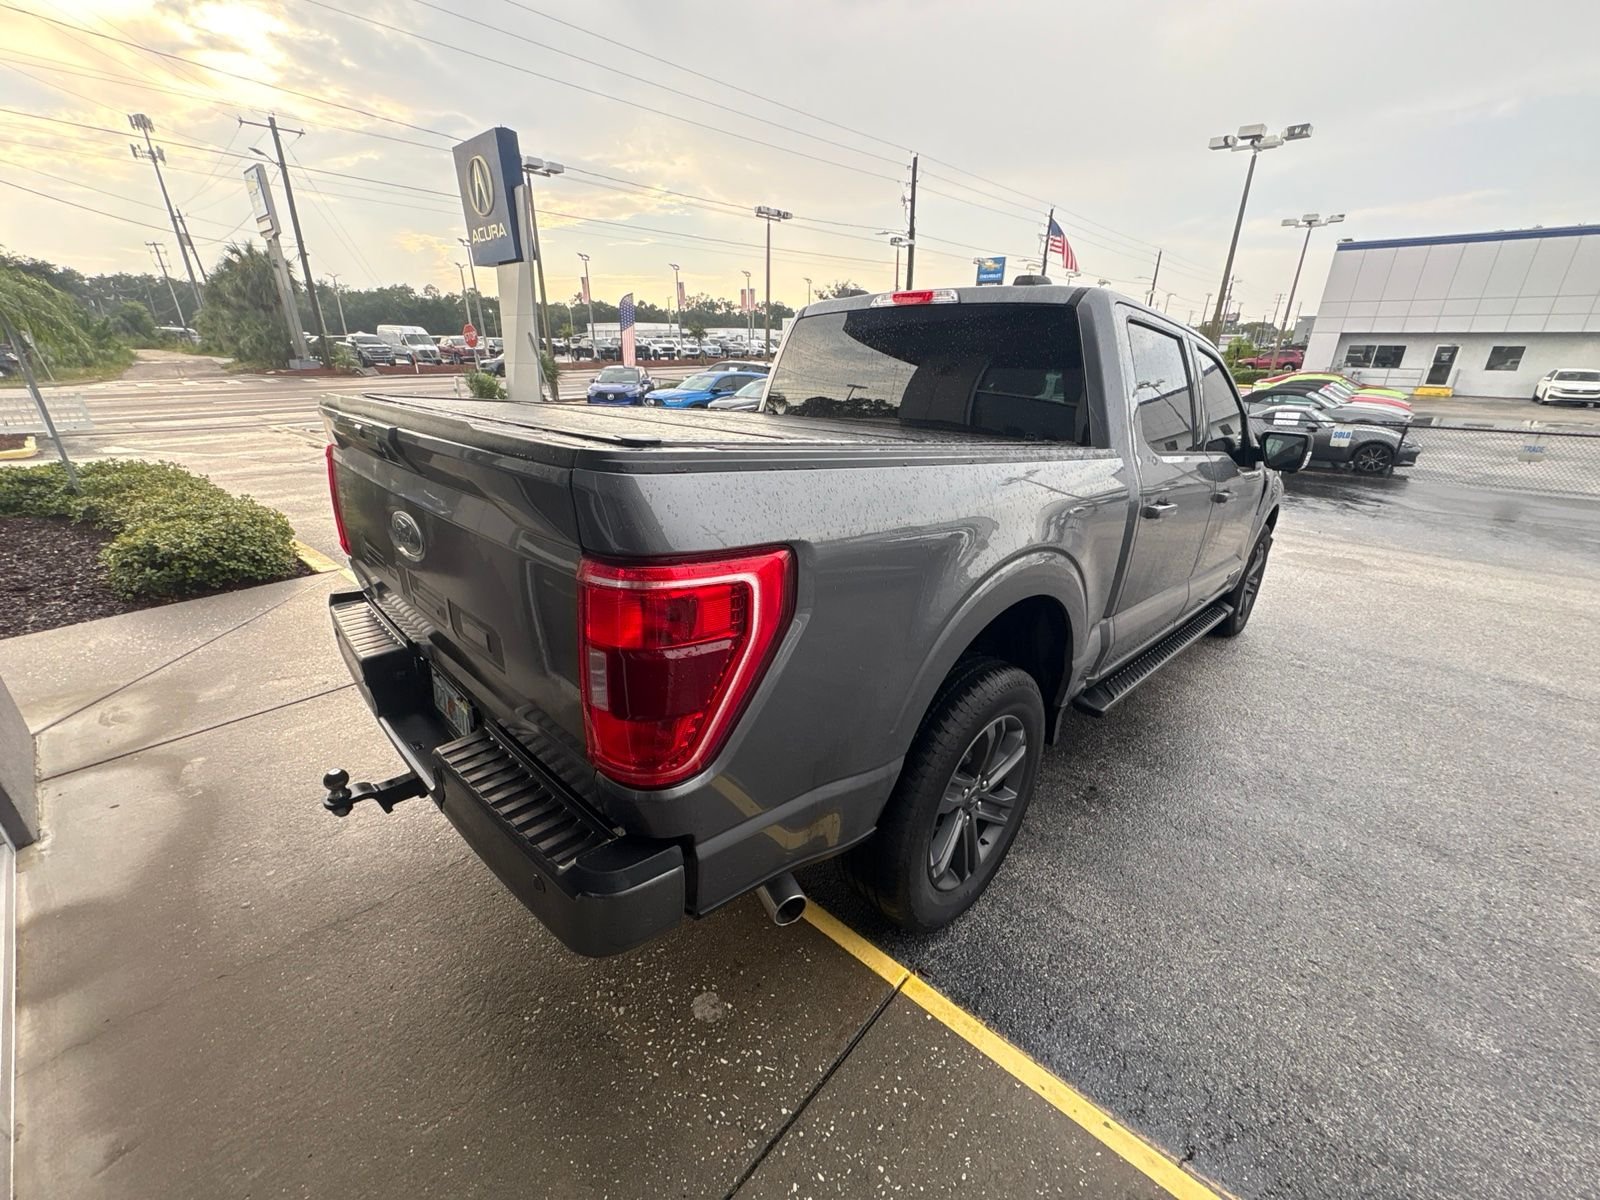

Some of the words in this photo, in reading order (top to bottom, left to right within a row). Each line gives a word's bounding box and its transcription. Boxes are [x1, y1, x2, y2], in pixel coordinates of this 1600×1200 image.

[472, 222, 507, 244] ACURA
[464, 331, 477, 342] STOP
[1333, 431, 1351, 439] SOLD
[1523, 445, 1545, 453] TRADE
